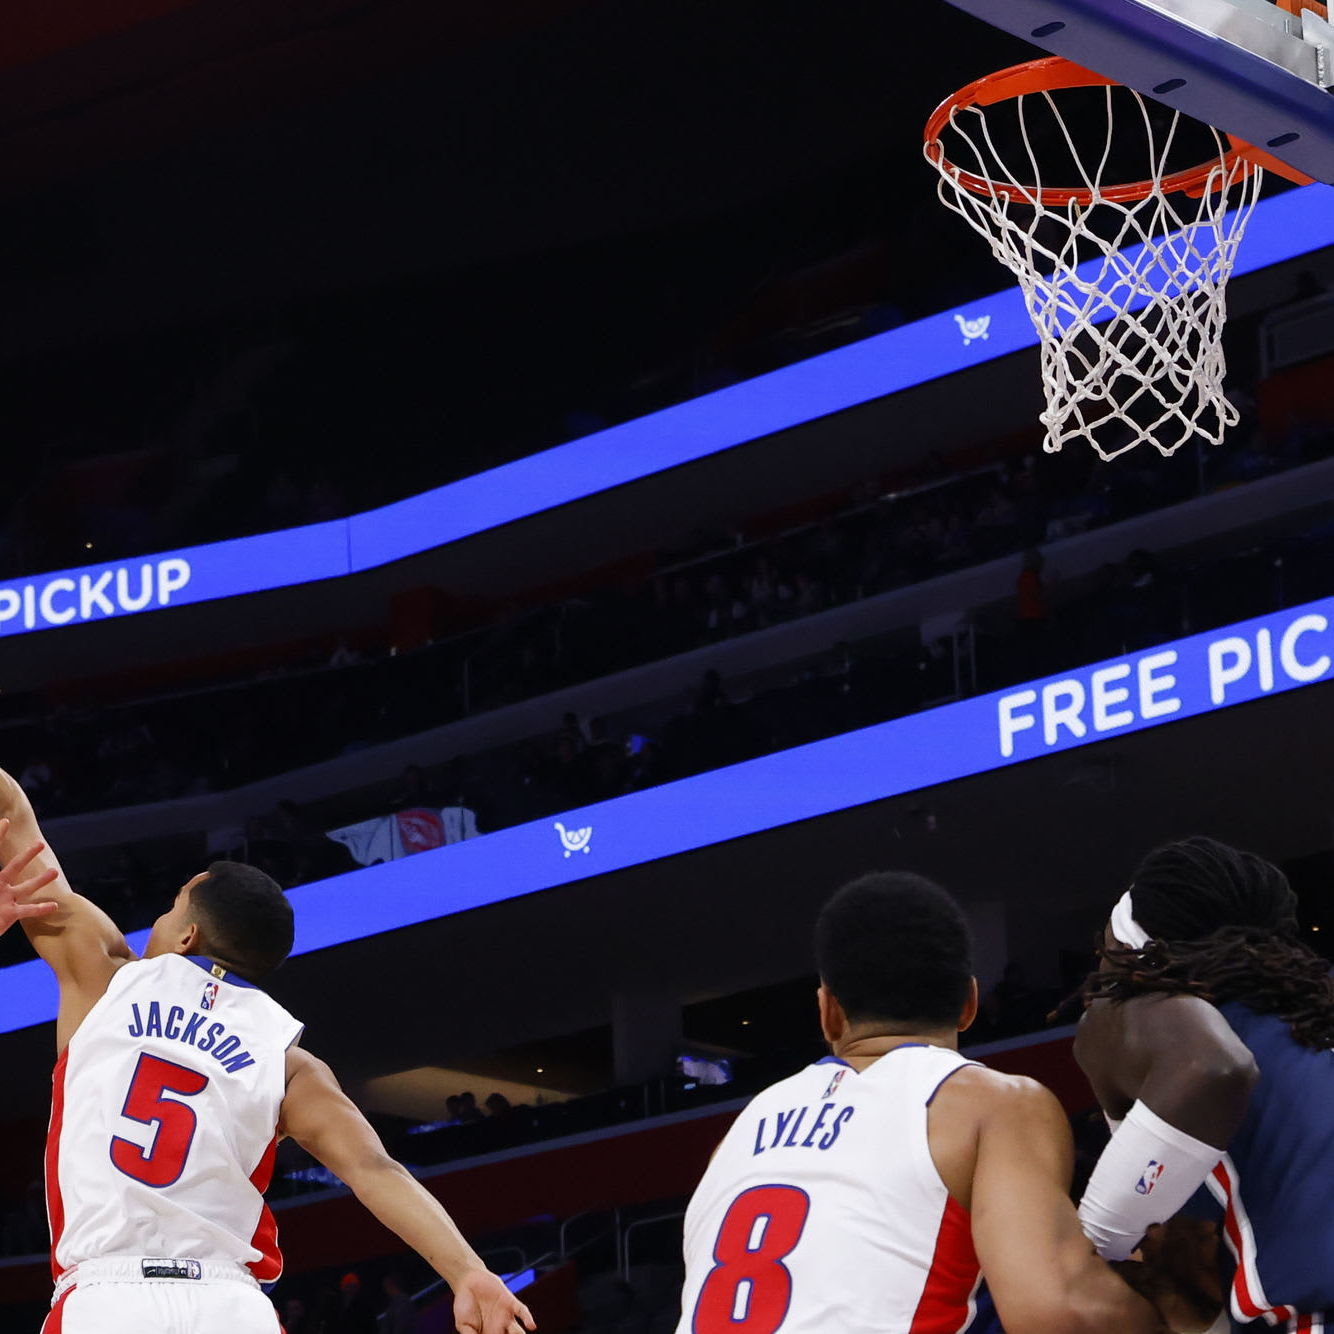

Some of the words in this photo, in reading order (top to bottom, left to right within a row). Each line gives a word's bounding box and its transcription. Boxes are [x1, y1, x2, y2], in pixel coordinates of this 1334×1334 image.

[998, 649, 1181, 757] FREE
[128, 1001, 255, 1074] JACKSON
[110, 1051, 209, 1189] 5
[752, 1102, 854, 1157] LYLES
